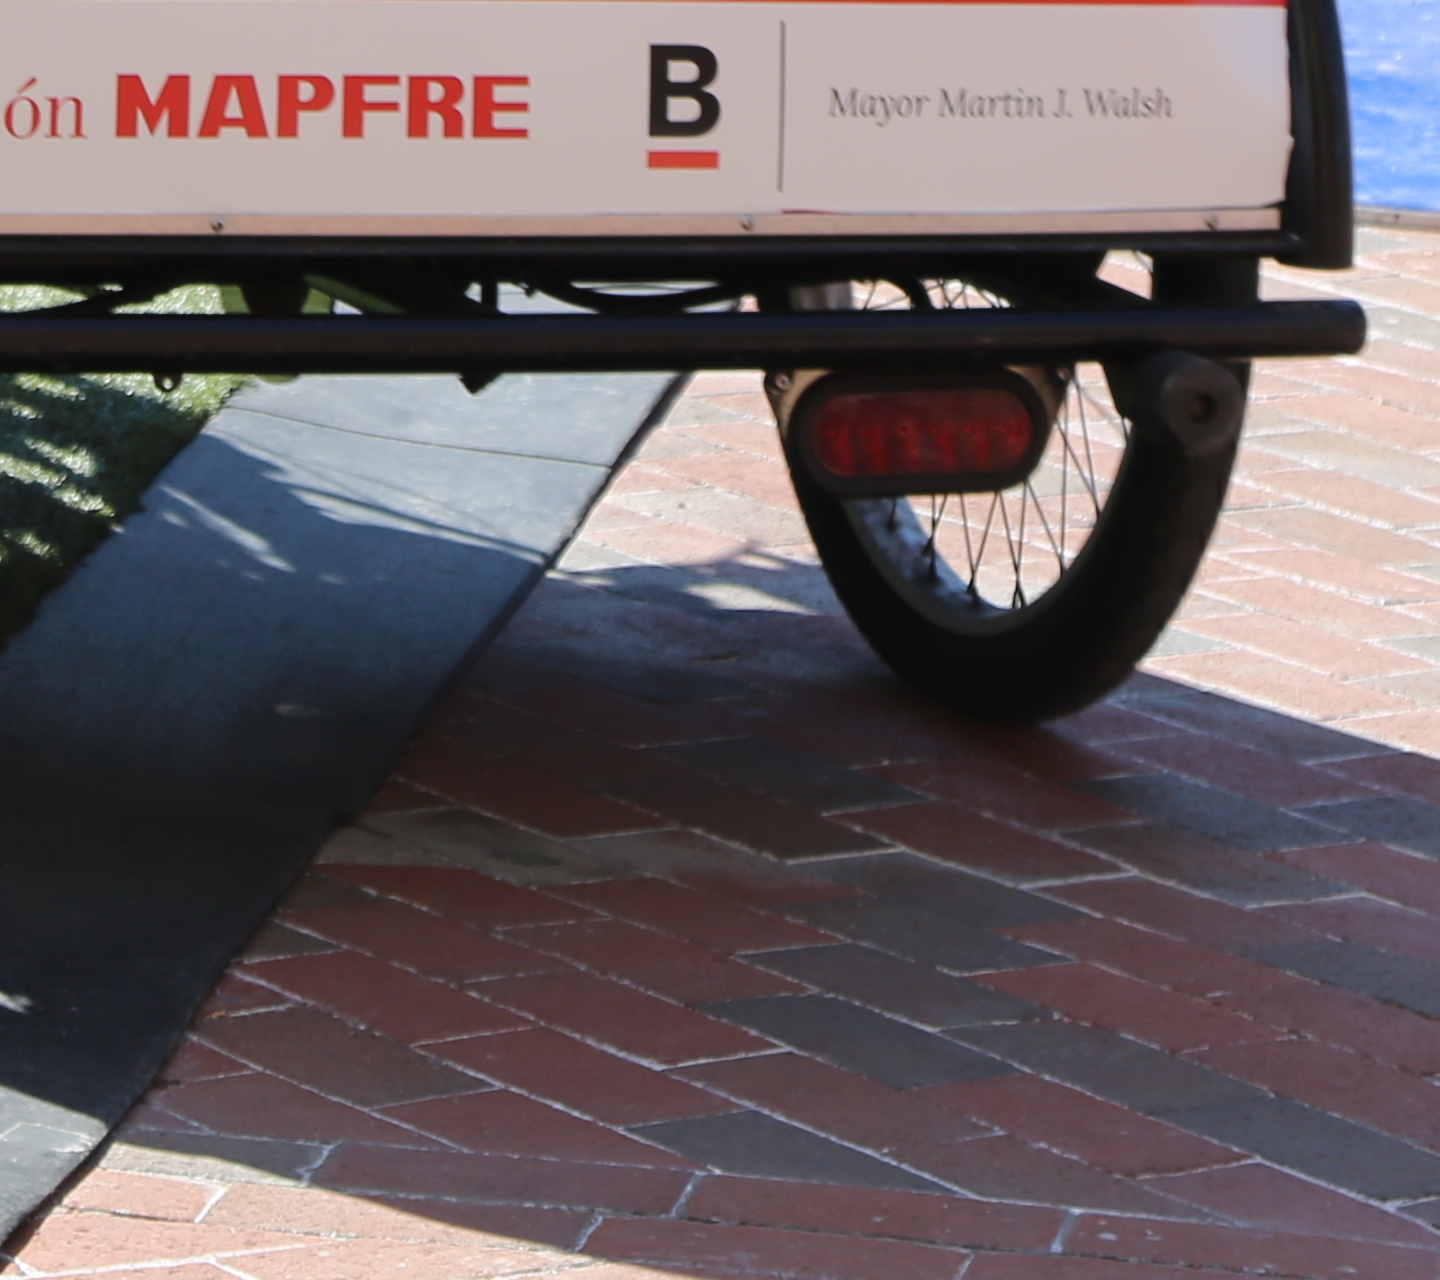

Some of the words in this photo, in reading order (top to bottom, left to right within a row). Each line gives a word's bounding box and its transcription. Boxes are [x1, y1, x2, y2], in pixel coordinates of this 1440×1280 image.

[114, 72, 531, 142] MAPFRE
[648, 43, 721, 138] B
[828, 87, 931, 128] Mayor
[937, 87, 1044, 120] Martin
[1052, 88, 1072, 121] J.
[1081, 88, 1174, 120] Walsh
